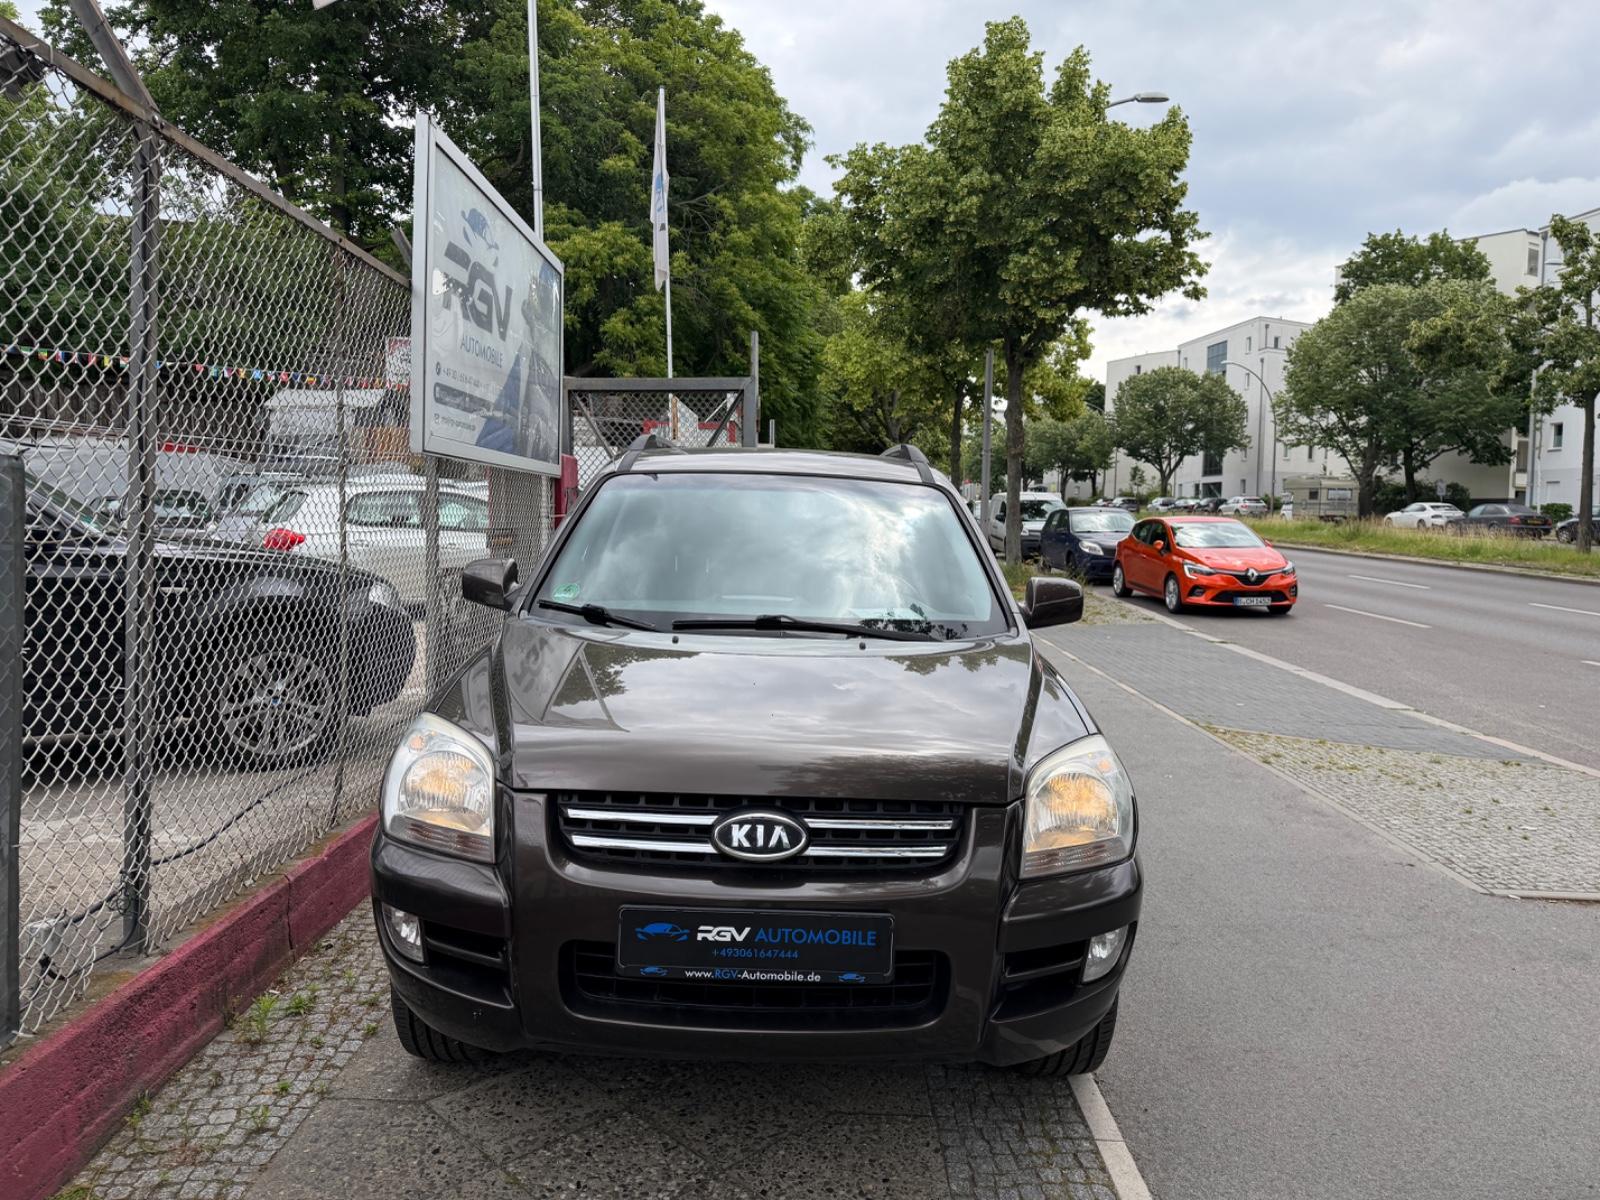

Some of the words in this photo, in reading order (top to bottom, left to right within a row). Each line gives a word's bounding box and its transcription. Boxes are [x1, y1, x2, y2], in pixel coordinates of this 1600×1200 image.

[442, 240, 513, 342] RGV
[460, 333, 504, 369] AUTOMOBILE
[731, 824, 791, 849] KIA
[696, 925, 752, 942] RGV
[754, 927, 877, 946] AUTOMOBILE
[712, 948, 799, 959] +493061647444
[685, 968, 821, 982] www.RGV-Automobile.de
